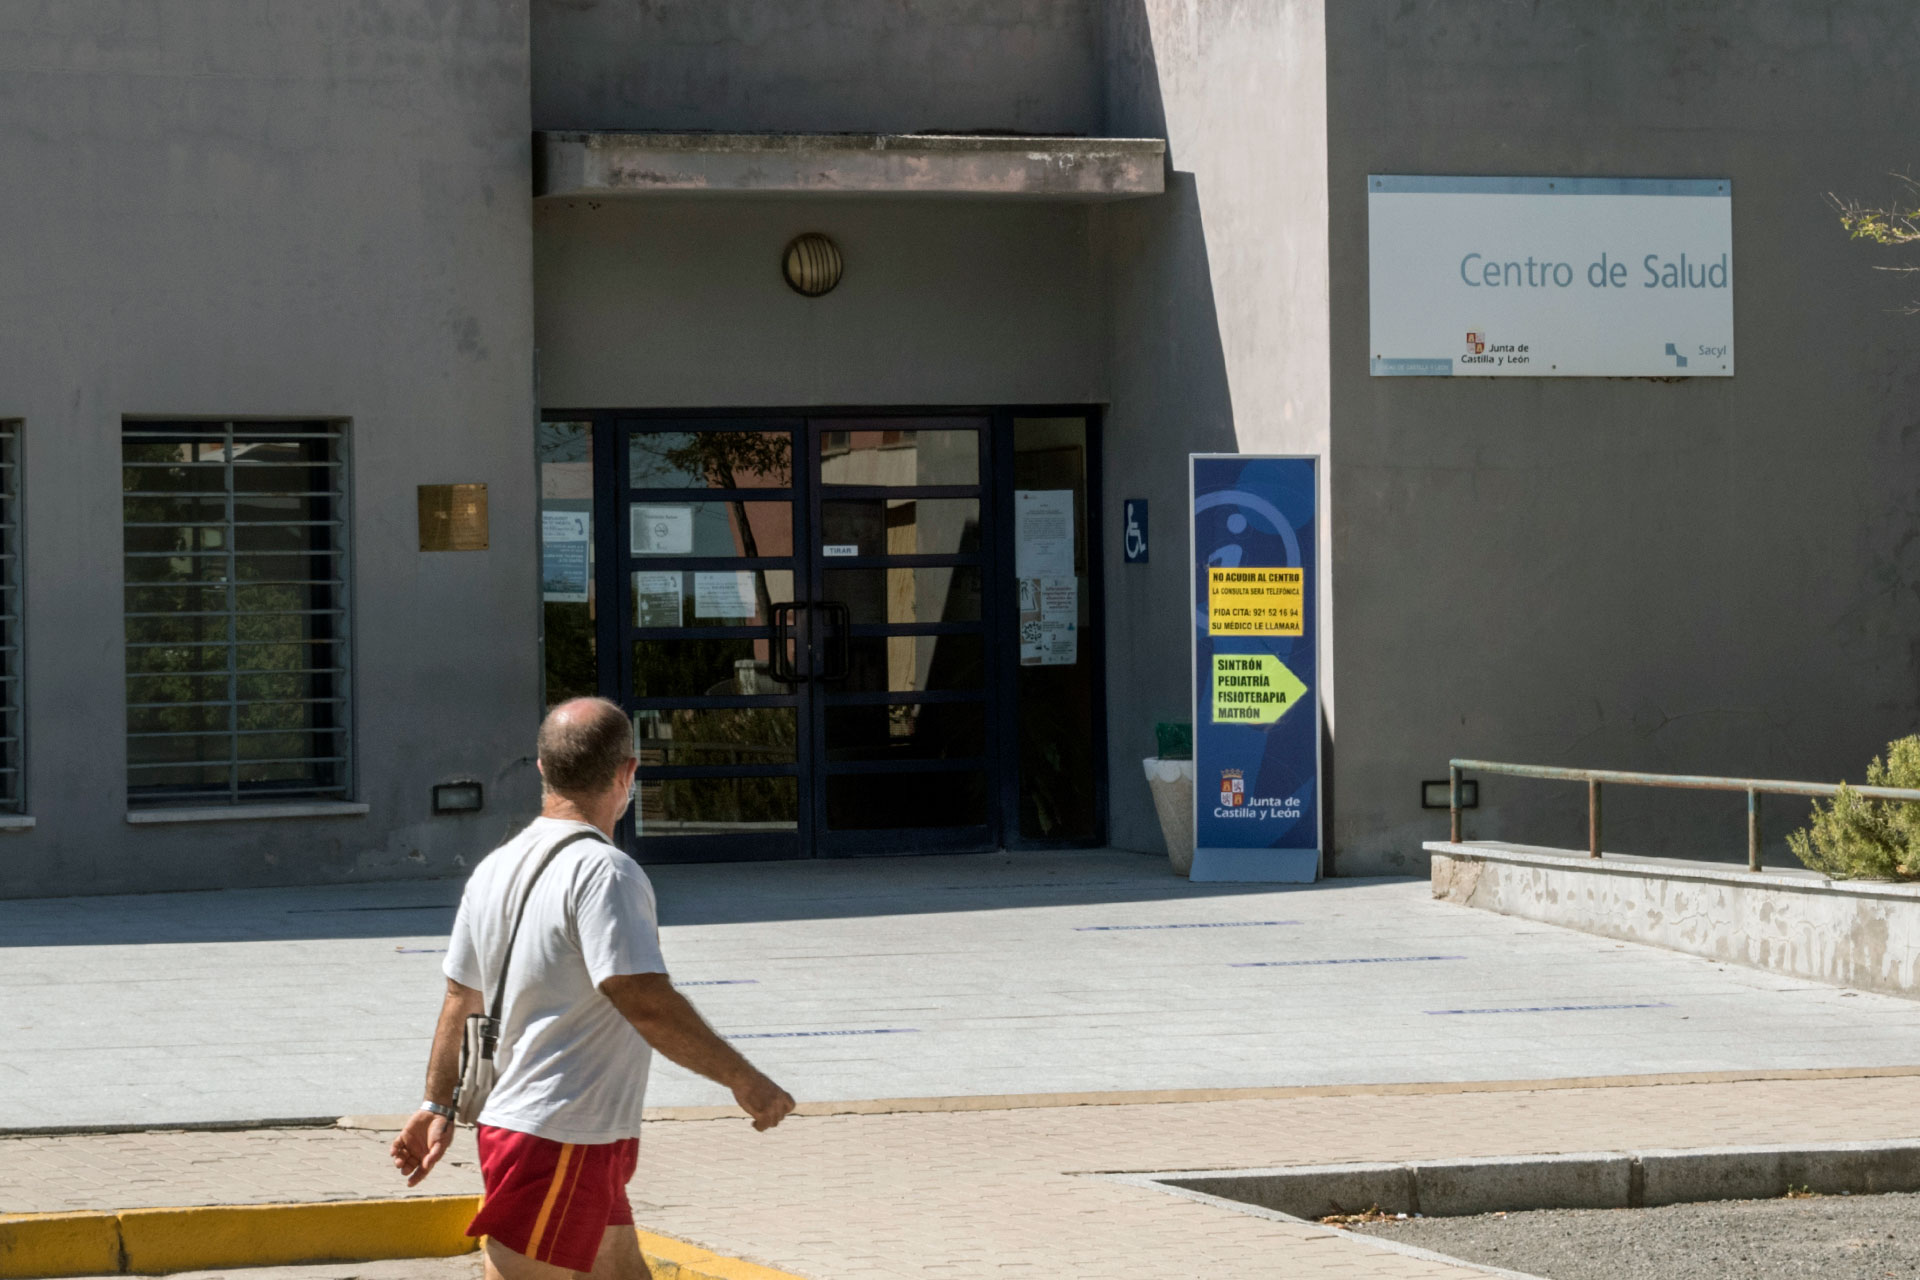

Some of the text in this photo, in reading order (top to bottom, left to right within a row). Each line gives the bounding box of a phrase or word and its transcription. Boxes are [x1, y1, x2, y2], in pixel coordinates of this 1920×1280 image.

[1460, 251, 1729, 289] Centro de Salud
[1488, 343, 1529, 353] Junta de
[1698, 343, 1728, 358] Sacyl
[1460, 353, 1530, 367] Castilla y León
[829, 547, 853, 556] TIRAR
[1213, 573, 1299, 582] NO ACUDIR AL CENTRO
[1214, 608, 1298, 616] PIDA CITA: 921 52 16 94
[1224, 621, 1252, 630] MÉDICO
[1254, 622, 1263, 630] LE
[1218, 658, 1262, 670] SINTRÓN
[1218, 675, 1270, 686] PEDIATRÍA
[1218, 692, 1286, 703] FISIOTERAPIA
[1218, 706, 1260, 718] MATRÓN
[1248, 797, 1300, 807] Junta de
[1214, 807, 1300, 820] Castilla y León
